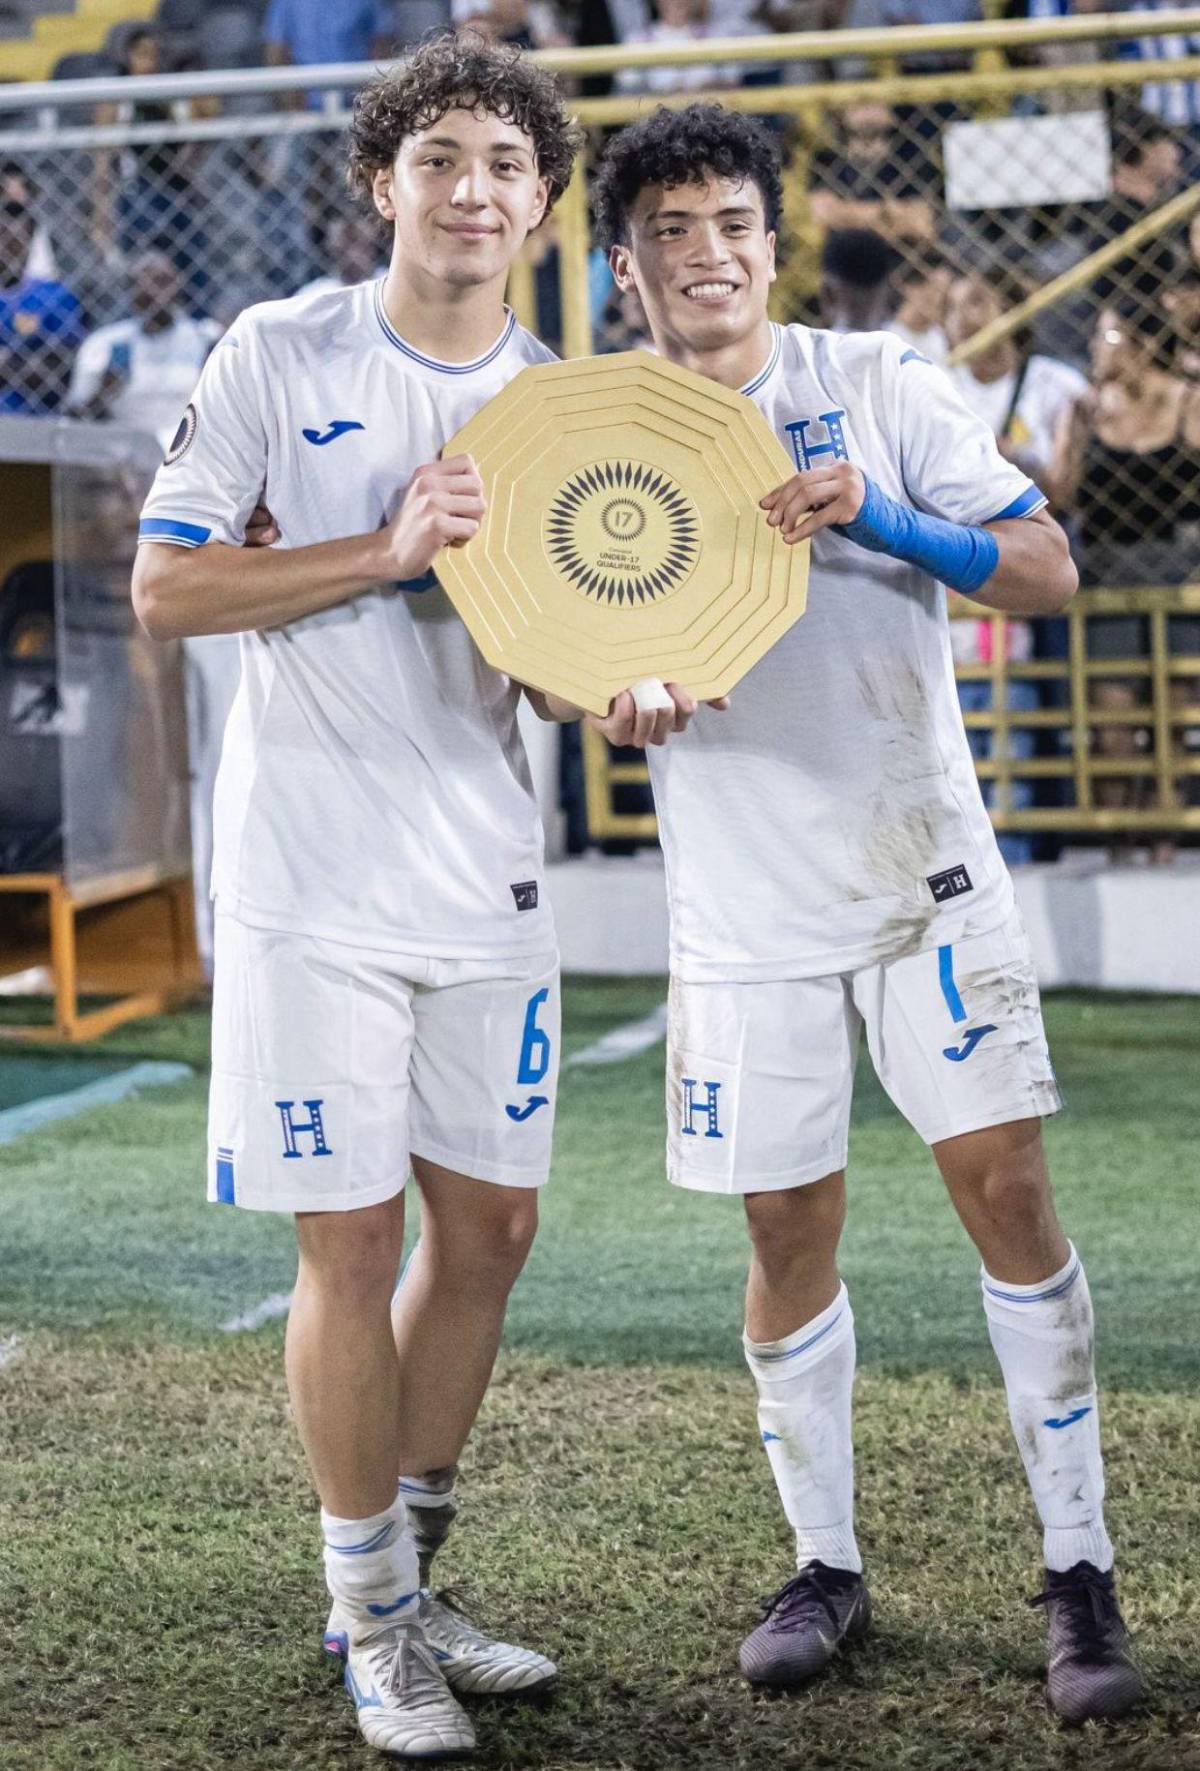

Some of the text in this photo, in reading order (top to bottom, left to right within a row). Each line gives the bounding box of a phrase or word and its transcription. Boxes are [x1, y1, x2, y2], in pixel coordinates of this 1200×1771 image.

[784, 410, 849, 470] H
[615, 511, 633, 528] 17
[596, 559, 641, 572] QUALIFIERS
[599, 552, 640, 563] UNDER-17
[953, 874, 967, 889] H
[517, 987, 550, 1084] 6
[681, 1078, 723, 1138] H
[275, 1099, 333, 1158] H
